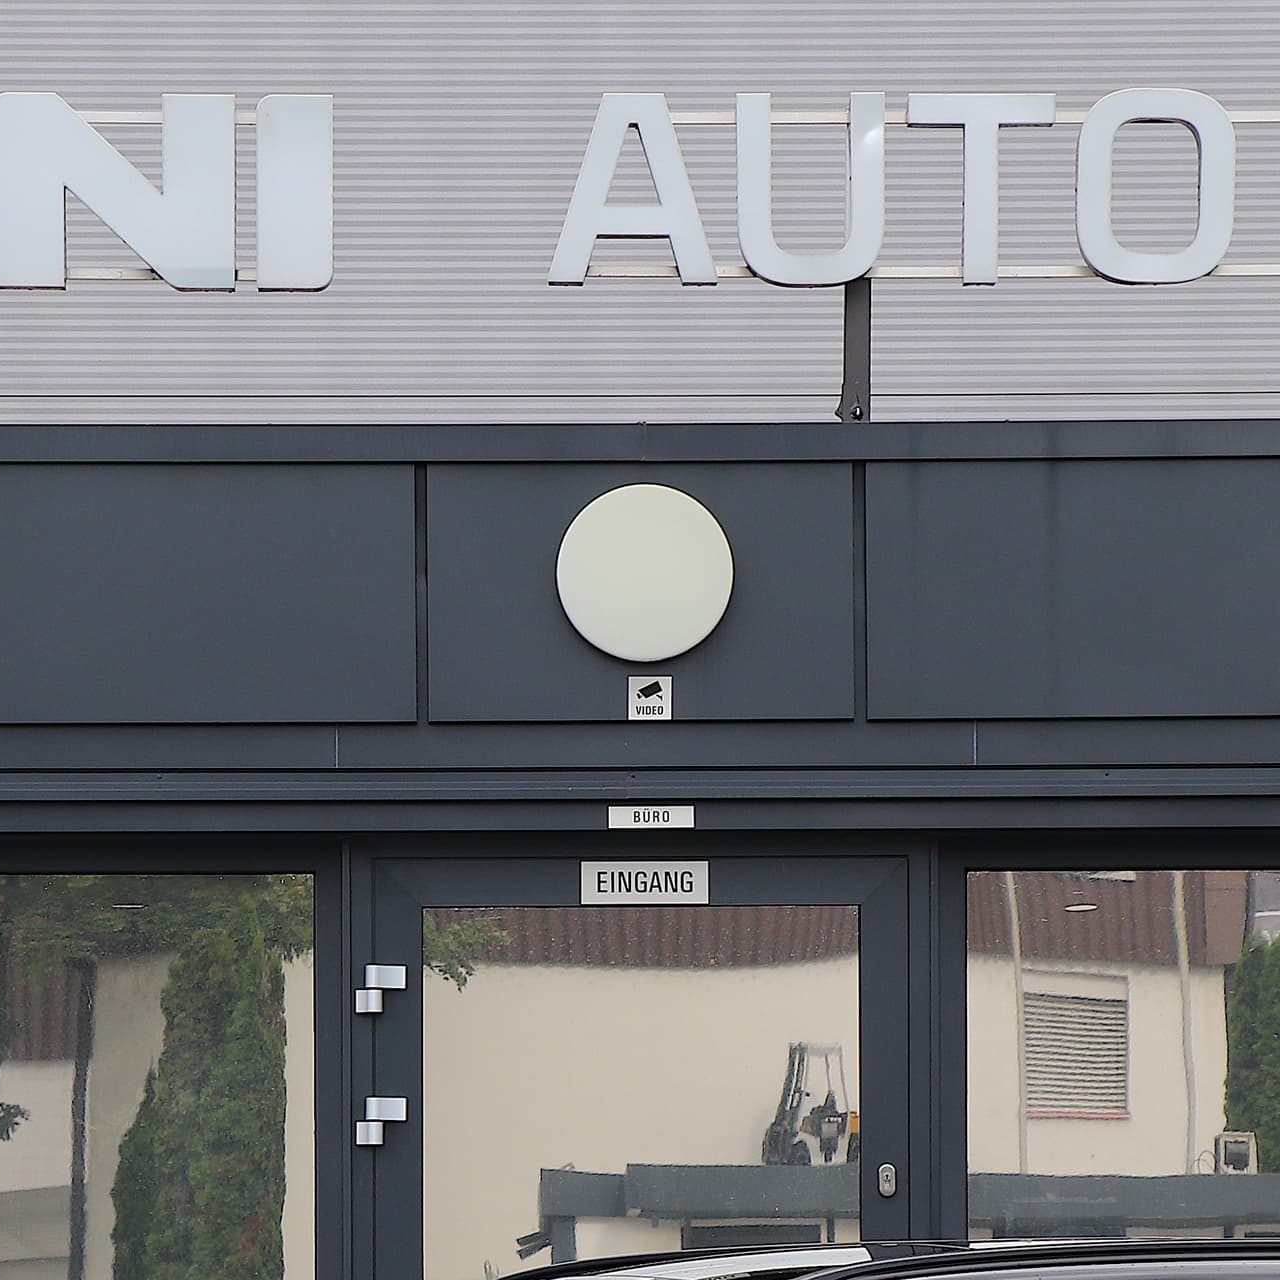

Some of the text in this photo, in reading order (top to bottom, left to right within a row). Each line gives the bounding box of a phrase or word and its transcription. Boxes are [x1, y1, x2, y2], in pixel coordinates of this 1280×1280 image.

[547, 87, 1236, 288] AUTO
[635, 705, 664, 716] VIDEO
[633, 808, 670, 823] BÜRO
[596, 871, 694, 893] EINGANG
